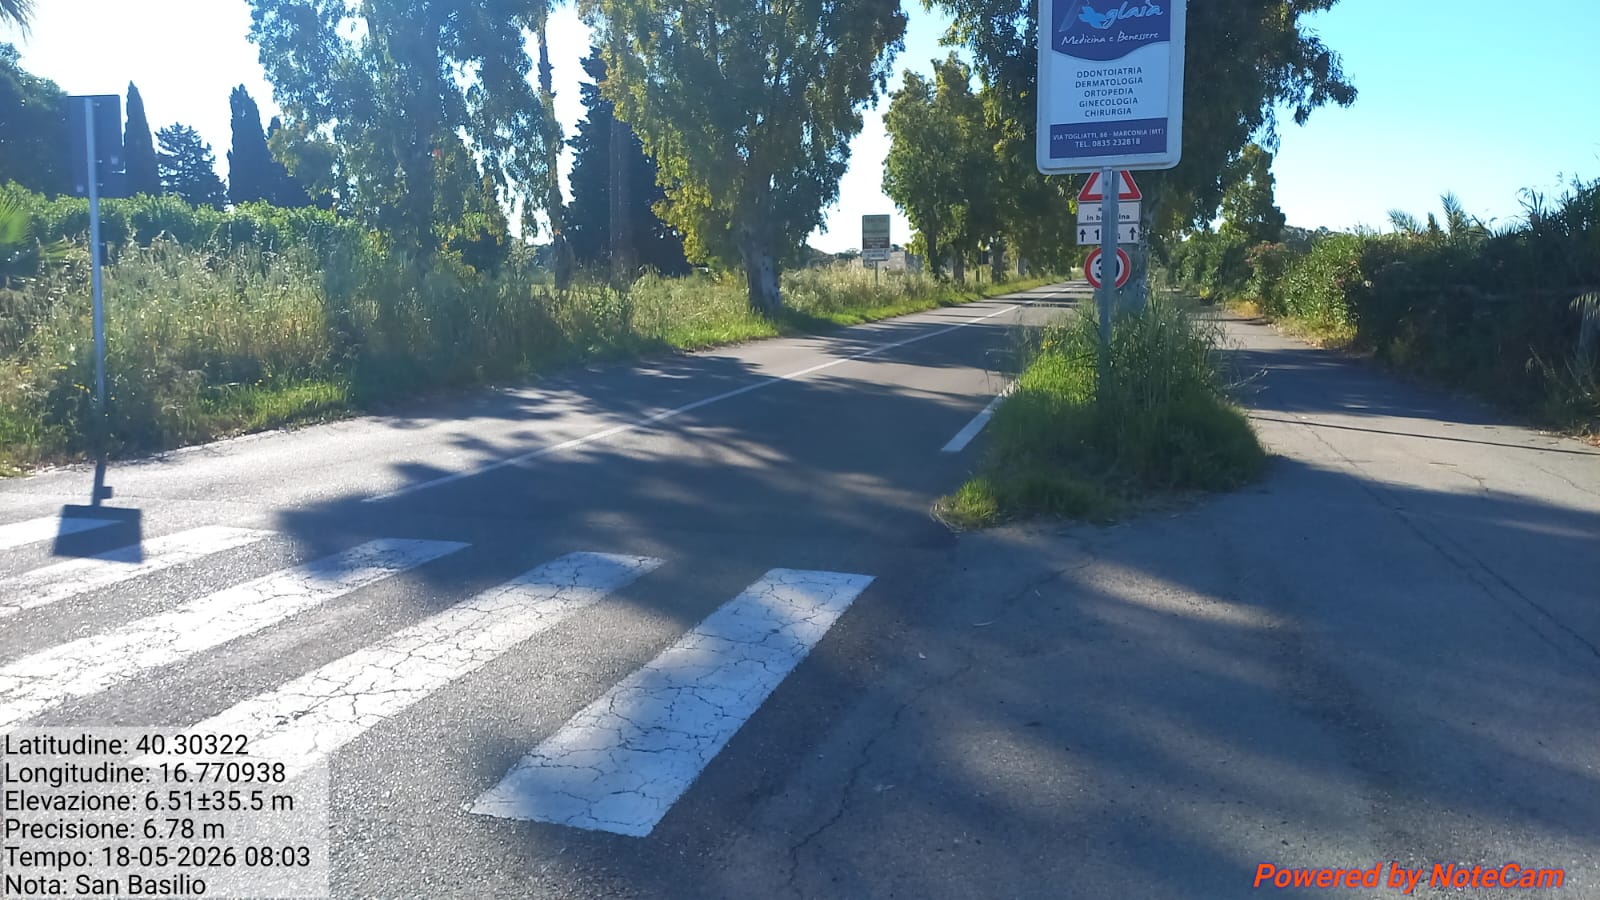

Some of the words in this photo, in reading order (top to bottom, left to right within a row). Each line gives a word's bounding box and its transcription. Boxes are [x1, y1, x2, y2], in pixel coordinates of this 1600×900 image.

[1061, 34, 1105, 46] Medicina
[1117, 31, 1159, 42] Benessere
[1076, 67, 1142, 78] ODONTOIATRIA
[1075, 77, 1143, 88] DERMATOLOGIA
[1084, 88, 1133, 97] ORTOPEDIA
[1079, 97, 1138, 108] GINECOLOGIA
[1085, 108, 1132, 117] CHIRURGIA
[1113, 129, 1147, 137] MARCONIA
[1149, 128, 1164, 136] (MT)
[1092, 139, 1110, 147] 0835
